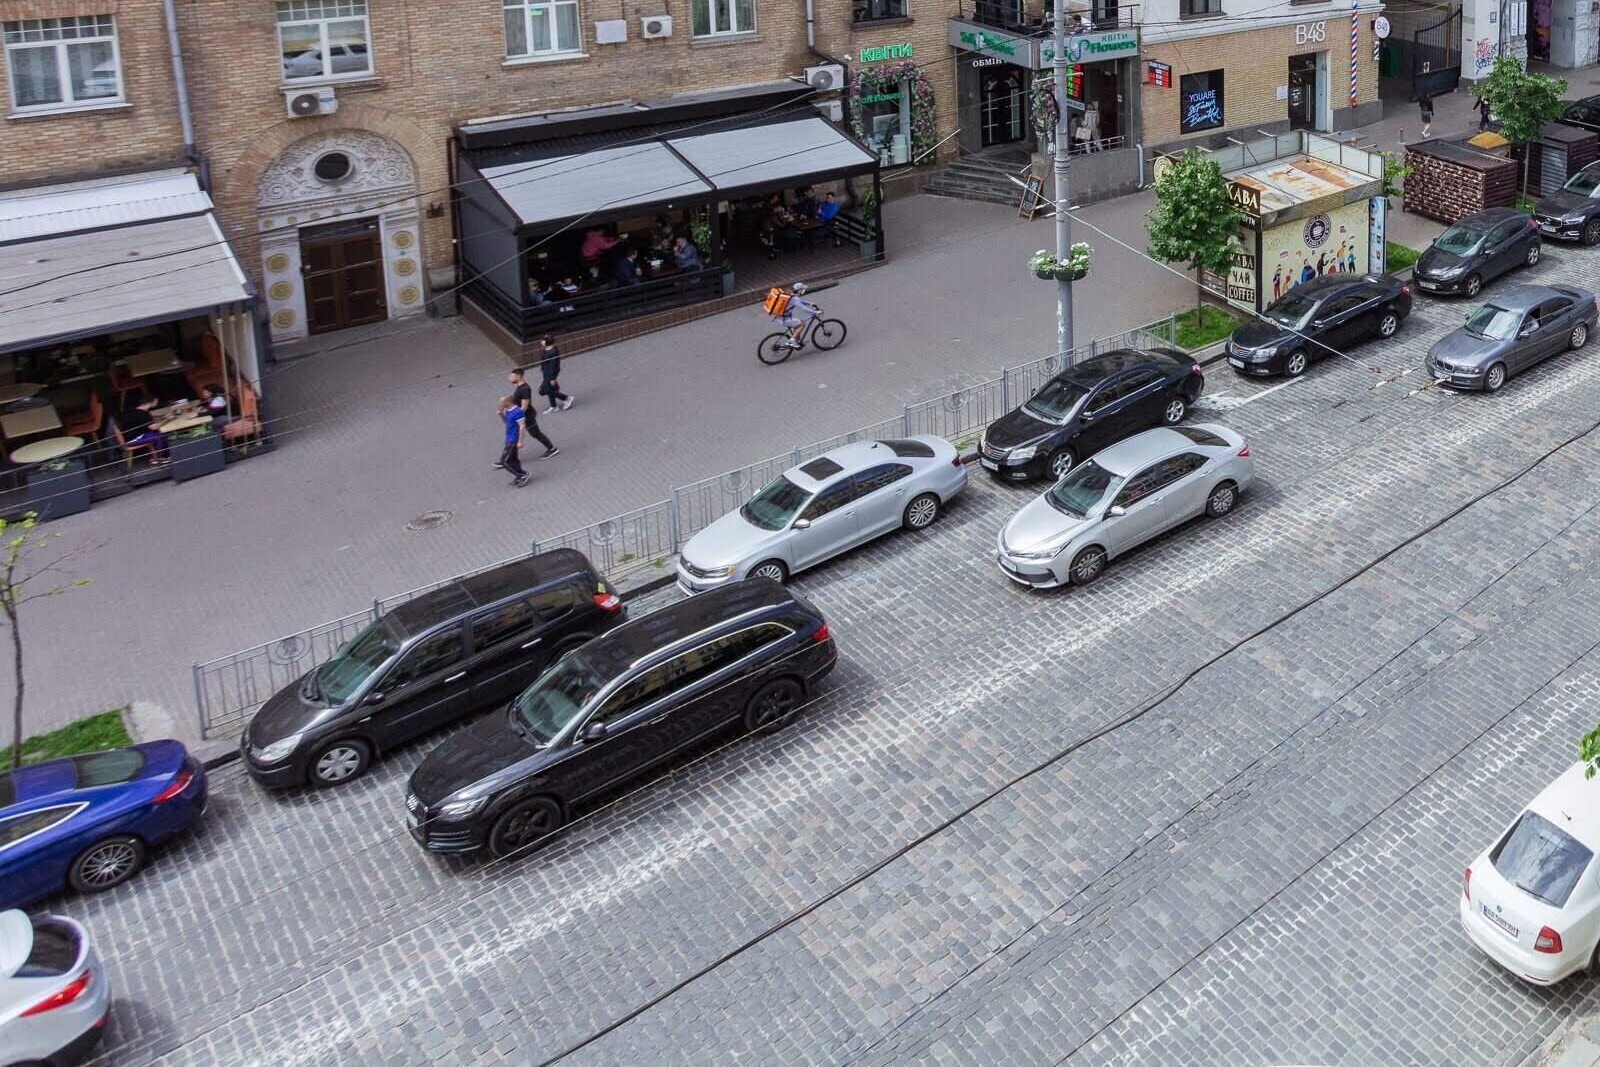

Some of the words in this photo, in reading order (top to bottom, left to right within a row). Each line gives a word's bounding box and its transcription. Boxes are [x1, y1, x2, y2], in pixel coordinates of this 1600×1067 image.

[1101, 33, 1128, 43] КВІТИ
[1295, 20, 1326, 45] B48
[860, 42, 913, 63] КВІТИ
[1089, 38, 1137, 54] Flowers
[1232, 270, 1250, 285] ЧАЙ
[1229, 286, 1254, 303] COFFEE
